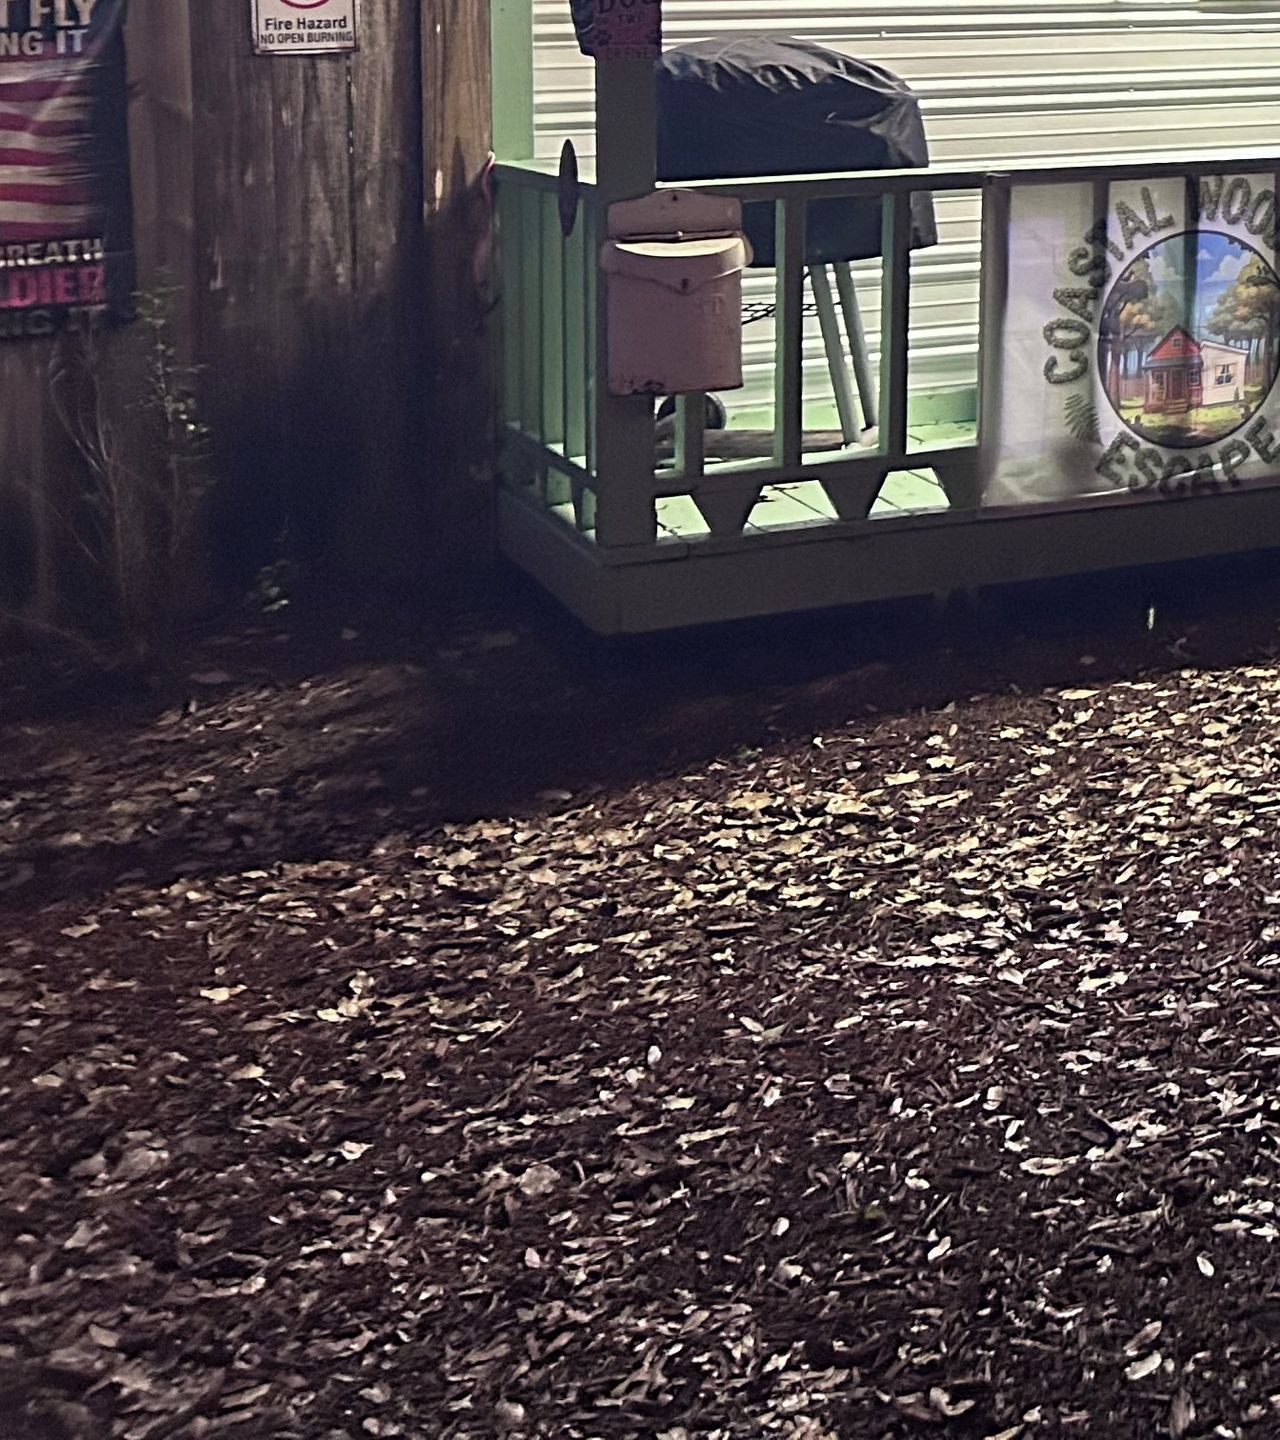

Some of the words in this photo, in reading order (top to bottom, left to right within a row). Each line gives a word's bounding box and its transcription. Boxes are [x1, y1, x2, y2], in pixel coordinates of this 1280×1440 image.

[265, 18, 293, 30] Fire
[296, 16, 347, 30] Hazard
[56, 29, 88, 54] IT
[260, 34, 275, 44] NO
[277, 33, 304, 44] OPEN
[307, 31, 353, 43] BURNING
[0, 264, 105, 308] DIER
[1043, 185, 1175, 385] COASTAL
